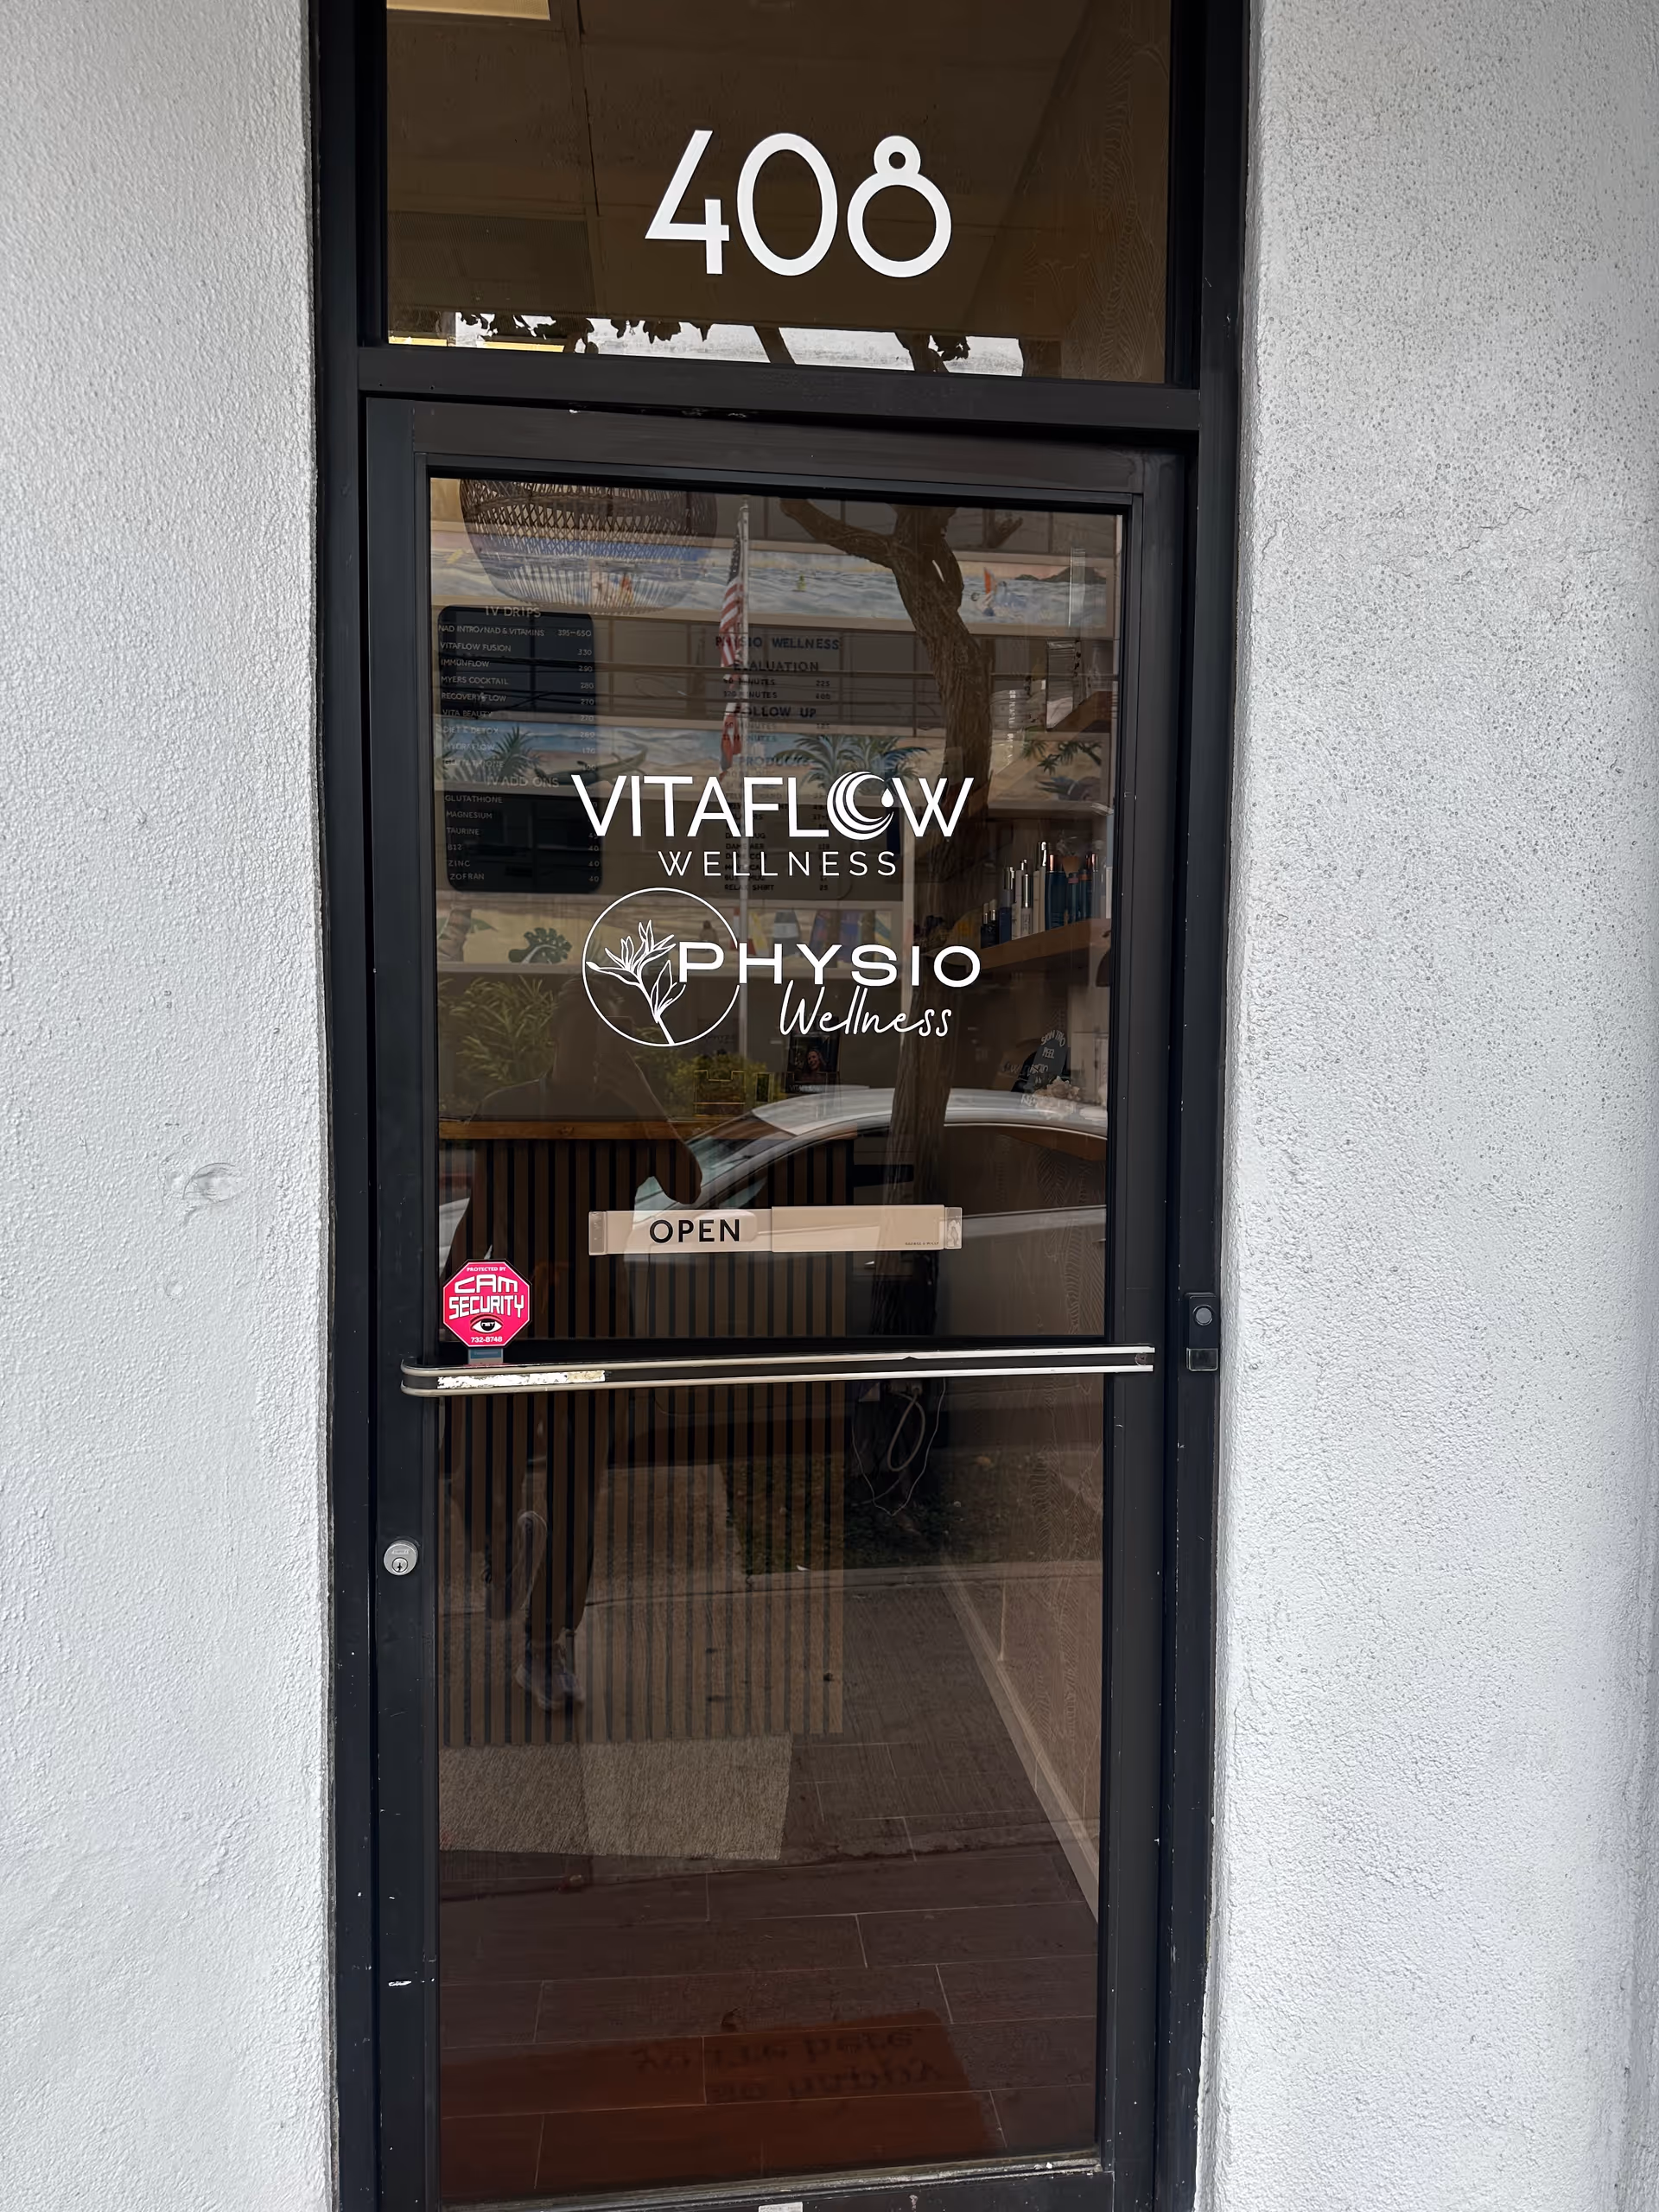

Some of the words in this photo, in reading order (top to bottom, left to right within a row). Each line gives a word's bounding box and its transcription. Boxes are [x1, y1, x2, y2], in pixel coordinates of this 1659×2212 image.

[645, 130, 952, 278] 408
[486, 606, 500, 616] IV
[504, 607, 542, 618] DRIPS
[509, 628, 545, 637] VITAMINS
[440, 642, 480, 651] VITAFLOW
[482, 644, 512, 652] FUSION
[772, 638, 840, 650] WELLNESS
[469, 677, 509, 685] COCKTAIL
[740, 690, 778, 699] NUTES
[800, 707, 817, 718] UP
[532, 777, 559, 788] ONS
[445, 794, 503, 804] GLUTATHIONE
[571, 771, 975, 840] VITAFLOW
[446, 810, 493, 819] MAGNESIUM
[446, 827, 480, 836] TAURINE
[658, 850, 896, 877] WELLNESS
[679, 941, 982, 988] PHYSIO
[779, 979, 952, 1037] Wellness
[650, 1219, 740, 1243] OPEN
[454, 1274, 518, 1294] CAM
[448, 1294, 524, 1320] SECURITY
